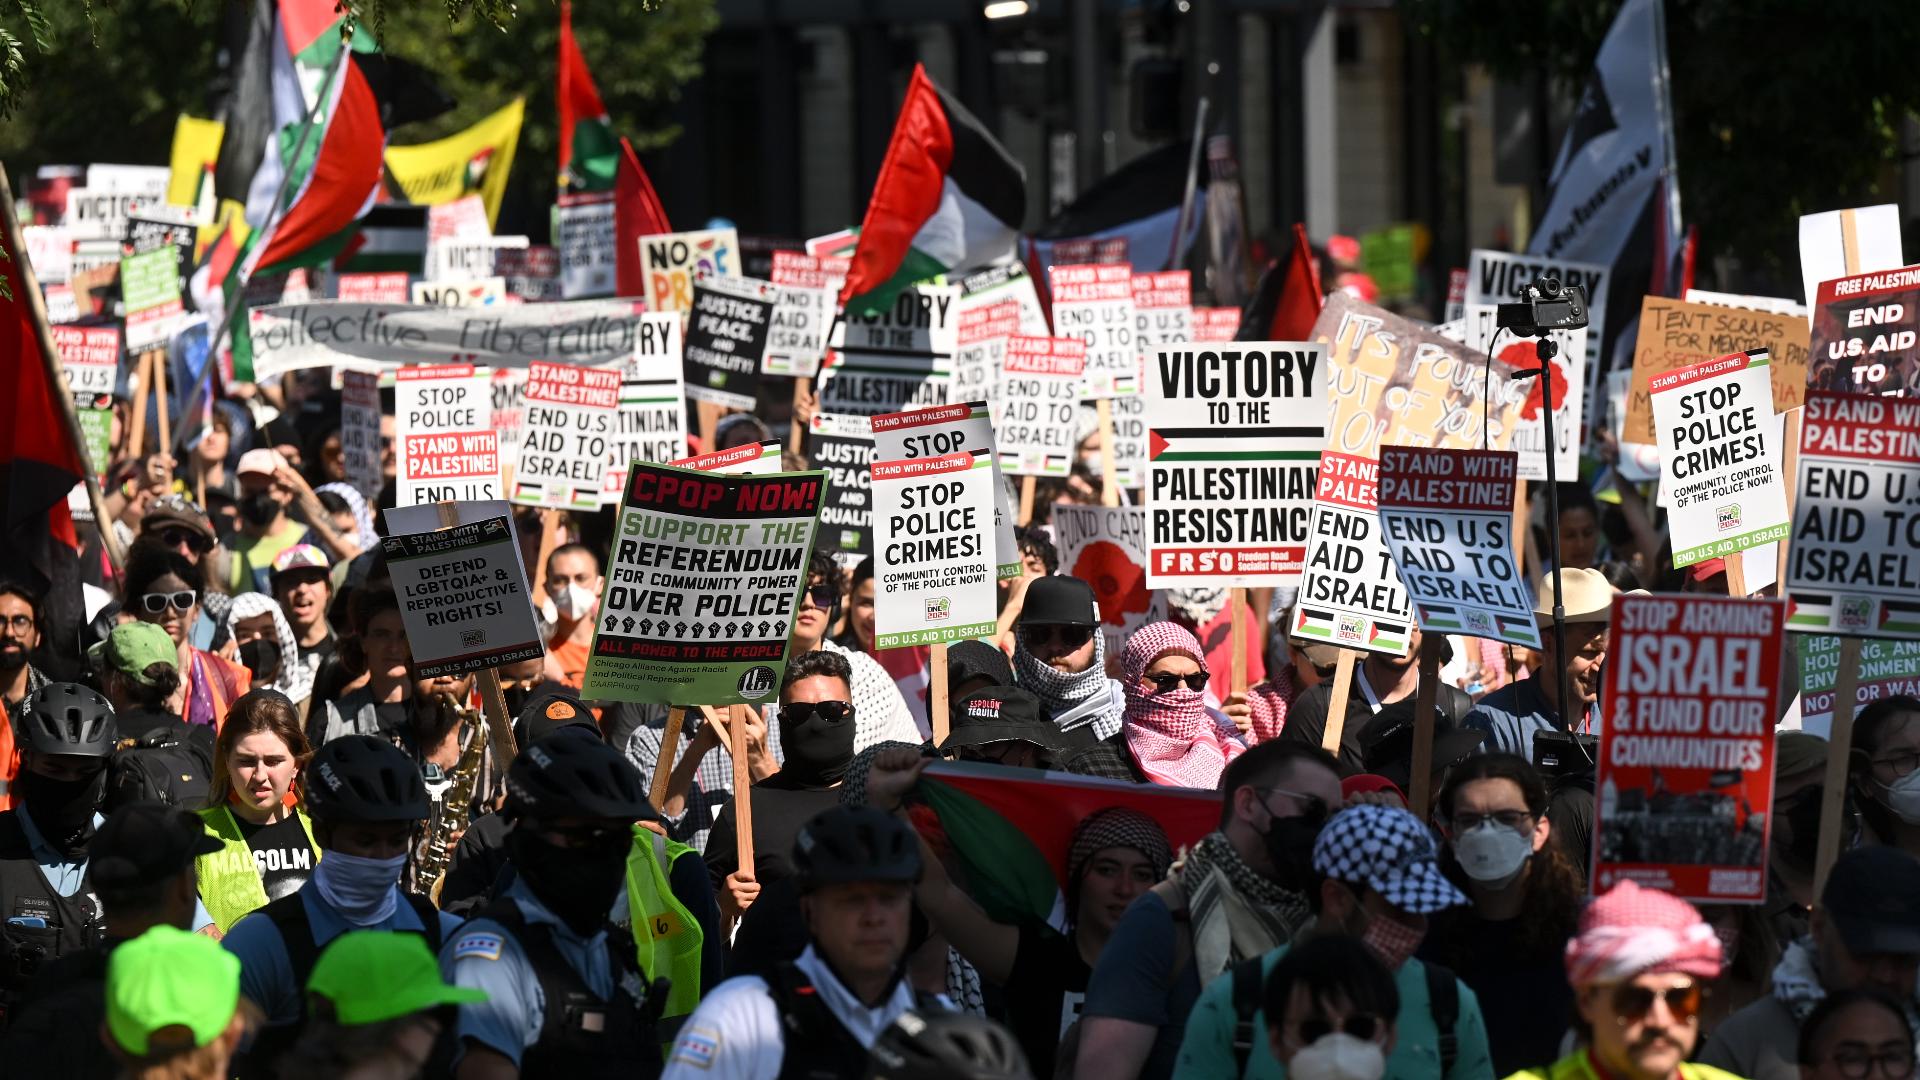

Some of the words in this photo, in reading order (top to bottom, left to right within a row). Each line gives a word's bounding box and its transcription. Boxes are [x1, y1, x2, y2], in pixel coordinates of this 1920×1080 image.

[648, 241, 689, 270] NO
[1053, 268, 1096, 285] STAND
[1834, 279, 1862, 297] FREE
[773, 311, 808, 330] AID
[1061, 309, 1094, 326] END
[1648, 306, 1711, 331] TENT
[1714, 315, 1785, 338] SCRAPS
[1847, 304, 1904, 329] END
[889, 328, 913, 347] THE
[1008, 337, 1050, 353] STAND
[1664, 330, 1701, 350] FOR
[1868, 330, 1917, 354] AID
[529, 365, 580, 382] STAND
[583, 370, 620, 388] WITH
[1157, 350, 1319, 399] VICTORY
[1652, 375, 1678, 389] STAND
[1679, 368, 1698, 382] WITH
[1699, 356, 1742, 376] PALESTINE!
[1851, 363, 1887, 385] TO
[418, 386, 467, 407] STOP
[527, 381, 618, 407] PALESTINE!
[1007, 378, 1041, 397] END
[1679, 382, 1742, 420] STOP
[1003, 402, 1039, 422] AID
[1048, 403, 1073, 424] TO
[1206, 401, 1230, 424] TO
[1236, 401, 1271, 424] THE
[1385, 386, 1431, 418] OF
[1806, 396, 1885, 425] STAND
[410, 409, 476, 429] POLICE
[527, 407, 568, 428] END
[874, 417, 900, 429] STAND
[901, 413, 921, 426] WITH
[921, 407, 964, 423] PALESTINE!
[1434, 398, 1505, 451] YOUR
[1672, 406, 1758, 451] POLICE
[407, 436, 459, 456] STAND
[461, 434, 496, 452] WITH
[523, 429, 565, 453] AID
[576, 435, 606, 458] TO
[902, 430, 966, 459] STOP
[1001, 426, 1071, 448] ISRAEL!
[409, 453, 498, 477] PALESTINE!
[520, 455, 601, 482] ISRAEL!
[698, 455, 717, 469] WITH
[718, 447, 756, 465] PALESTINE!
[875, 465, 901, 476] STAND
[902, 462, 924, 474] WITH
[925, 457, 967, 472] PALESTINE!
[1322, 456, 1379, 482] STAND
[1381, 451, 1455, 476] STAND
[1462, 455, 1514, 478] WITH
[1671, 432, 1766, 480] CRIMES!
[633, 472, 724, 510] CPOP
[736, 481, 818, 512] NOW!
[1152, 466, 1321, 501] PALESTINIAN
[1380, 478, 1512, 506] PALESTINE!
[1673, 475, 1728, 499] COMMUNITY
[1730, 463, 1774, 483] CONTROL
[1677, 497, 1690, 509] OF
[1692, 492, 1710, 506] THE
[1712, 482, 1745, 499] POLICE
[1747, 475, 1773, 491] NOW!
[1804, 466, 1870, 501] END
[839, 491, 866, 507] AND
[900, 481, 965, 510] STOP
[409, 531, 449, 546] STAND
[451, 524, 481, 539] WITH
[623, 512, 750, 546] SUPPORT
[760, 521, 809, 545] THE
[889, 506, 976, 539] POLICE
[1056, 508, 1099, 562] FUND
[1153, 507, 1312, 544] RESISTANC
[1316, 510, 1370, 541] END
[1386, 515, 1446, 544] END
[1456, 518, 1505, 550] U.S
[1797, 505, 1866, 544] AID
[416, 535, 479, 554] PALESTINE!
[617, 538, 804, 573] REFERENDUM
[884, 533, 982, 567] CRIMES!
[1238, 552, 1270, 562] Freedom
[1270, 551, 1289, 561] Road
[1310, 540, 1365, 574] AID
[1676, 551, 1696, 565] END
[1698, 545, 1715, 559] U.S
[1716, 540, 1735, 554] AID
[1736, 535, 1750, 549] TO
[1751, 524, 1790, 546] ISRAEL!
[418, 557, 488, 581] DEFEND
[883, 568, 940, 583] COMMUNITY
[943, 563, 988, 577] CONTROL
[1160, 550, 1234, 573] FRSO
[1238, 561, 1270, 572] Socialist
[1401, 545, 1456, 574] AID
[1464, 552, 1513, 582] TO
[1794, 546, 1920, 589] ISRAEL
[405, 573, 490, 598] LGBTQIA+
[494, 568, 509, 581] &
[613, 567, 645, 585] FOR
[650, 572, 743, 591] COMMUNITY
[746, 574, 798, 590] POWER
[885, 583, 899, 593] OF
[902, 580, 919, 591] THE
[923, 576, 957, 589] POLICE
[959, 573, 986, 586] NOW!
[1406, 573, 1525, 611] ISRAEL!
[406, 582, 519, 612] REPRODUCTIVE
[607, 585, 684, 617] OVER
[694, 592, 794, 618] POLICE
[1305, 572, 1411, 617] ISRAEL!
[425, 600, 504, 627] RIGHTS!
[1620, 601, 1679, 632] STOP
[1680, 602, 1774, 636] ARMING
[599, 639, 626, 654] ALL
[631, 643, 678, 658] POWER
[682, 645, 700, 658] TO
[704, 646, 729, 658] THE
[732, 643, 783, 658] PEOPLE
[878, 634, 899, 648] END
[902, 632, 918, 645] U.S
[921, 631, 939, 643] AID
[942, 628, 956, 640] TO
[957, 624, 995, 638] ISRAEL!
[420, 665, 441, 677] END
[444, 662, 461, 674] U.S
[464, 658, 482, 669] AID
[484, 655, 499, 666] TO
[501, 646, 541, 662] ISRAEL!
[594, 659, 631, 672] Chicago
[631, 662, 667, 673] Alliance
[667, 664, 700, 675] Against
[701, 664, 729, 674] Racist
[1615, 634, 1770, 697] ISRAEL
[592, 669, 610, 679] and
[611, 671, 646, 682] Political
[646, 673, 695, 684] Repression
[968, 707, 999, 718] TEQUILA
[1612, 695, 1632, 731] &
[1636, 697, 1704, 733] FUND
[1708, 700, 1765, 736] OUR
[1610, 734, 1763, 772] COMMUNITIES
[318, 761, 343, 792] POLICE
[209, 848, 310, 877] MALCOLM
